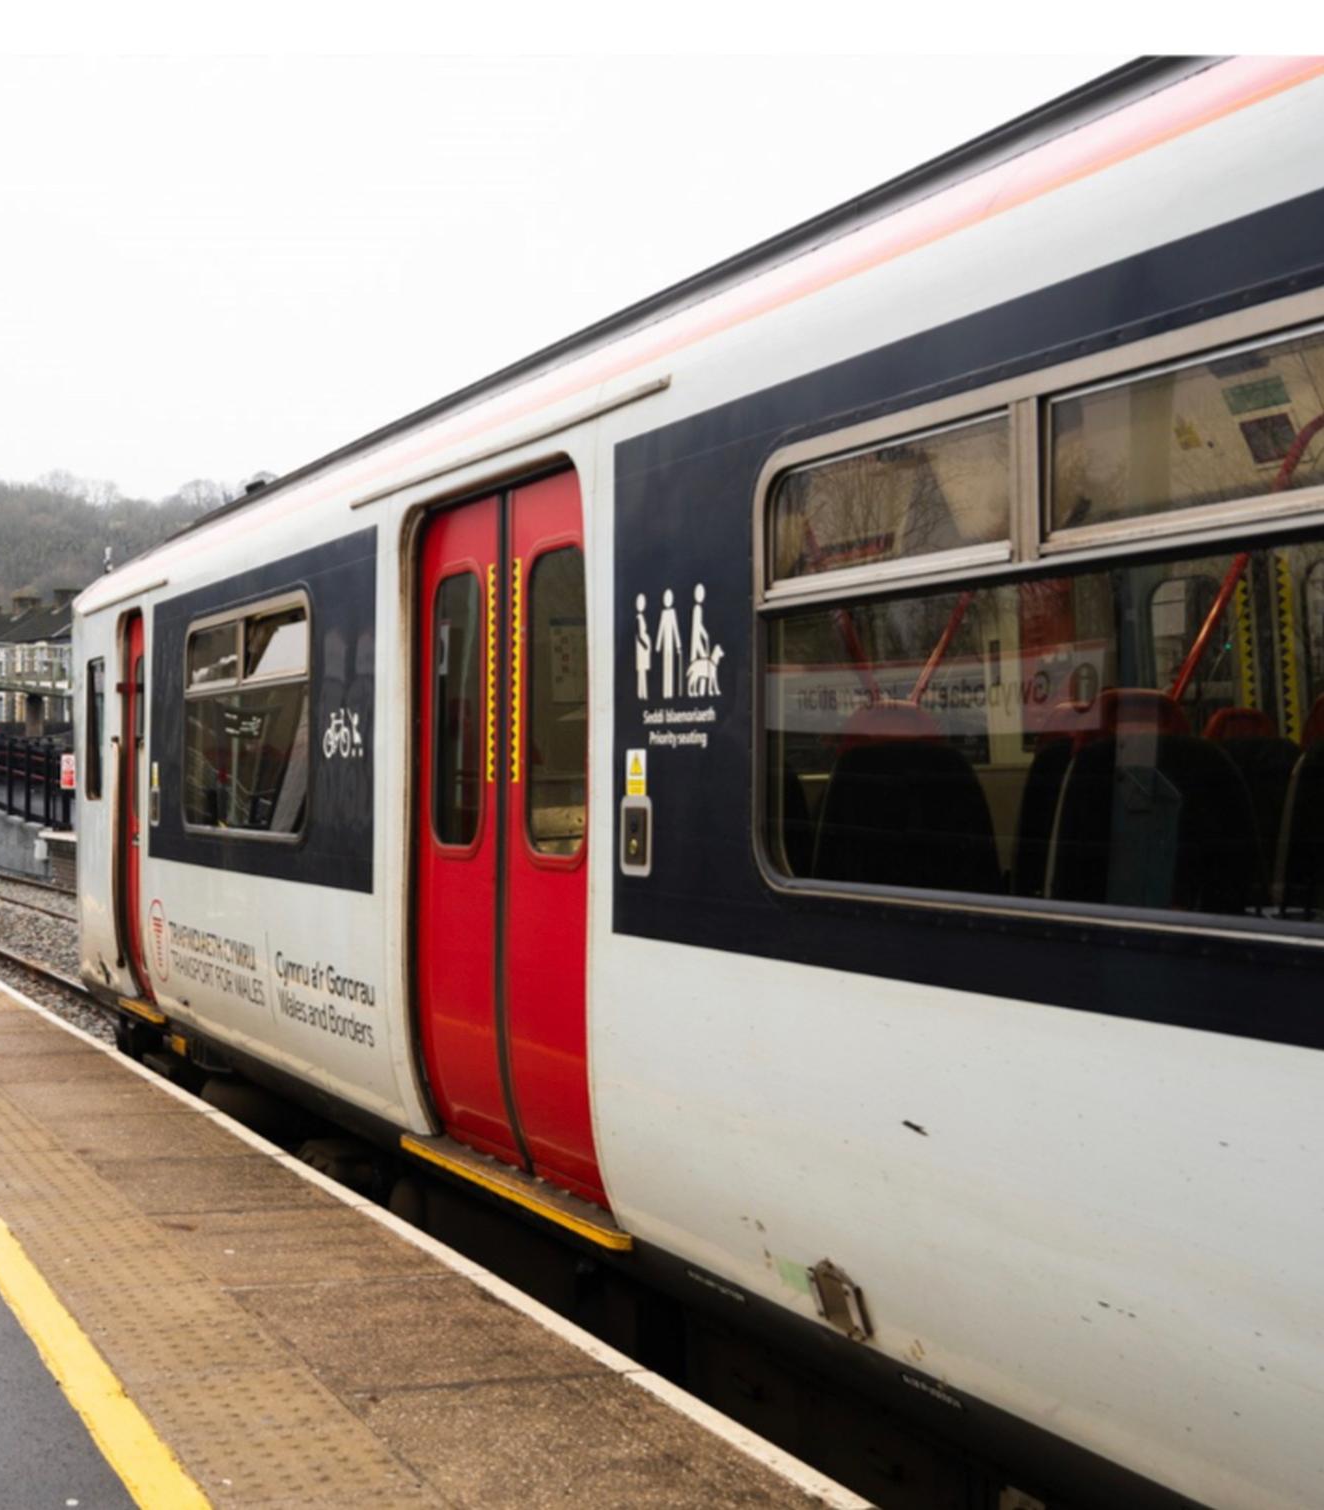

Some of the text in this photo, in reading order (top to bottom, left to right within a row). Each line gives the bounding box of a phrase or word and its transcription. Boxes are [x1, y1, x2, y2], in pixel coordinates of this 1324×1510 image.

[649, 729, 708, 749] Priority seating
[170, 949, 266, 1007] TRANSPORT FOR WALES
[275, 950, 375, 1007] Cymru a'r Gororau
[277, 988, 375, 1049] Wales and Borders
